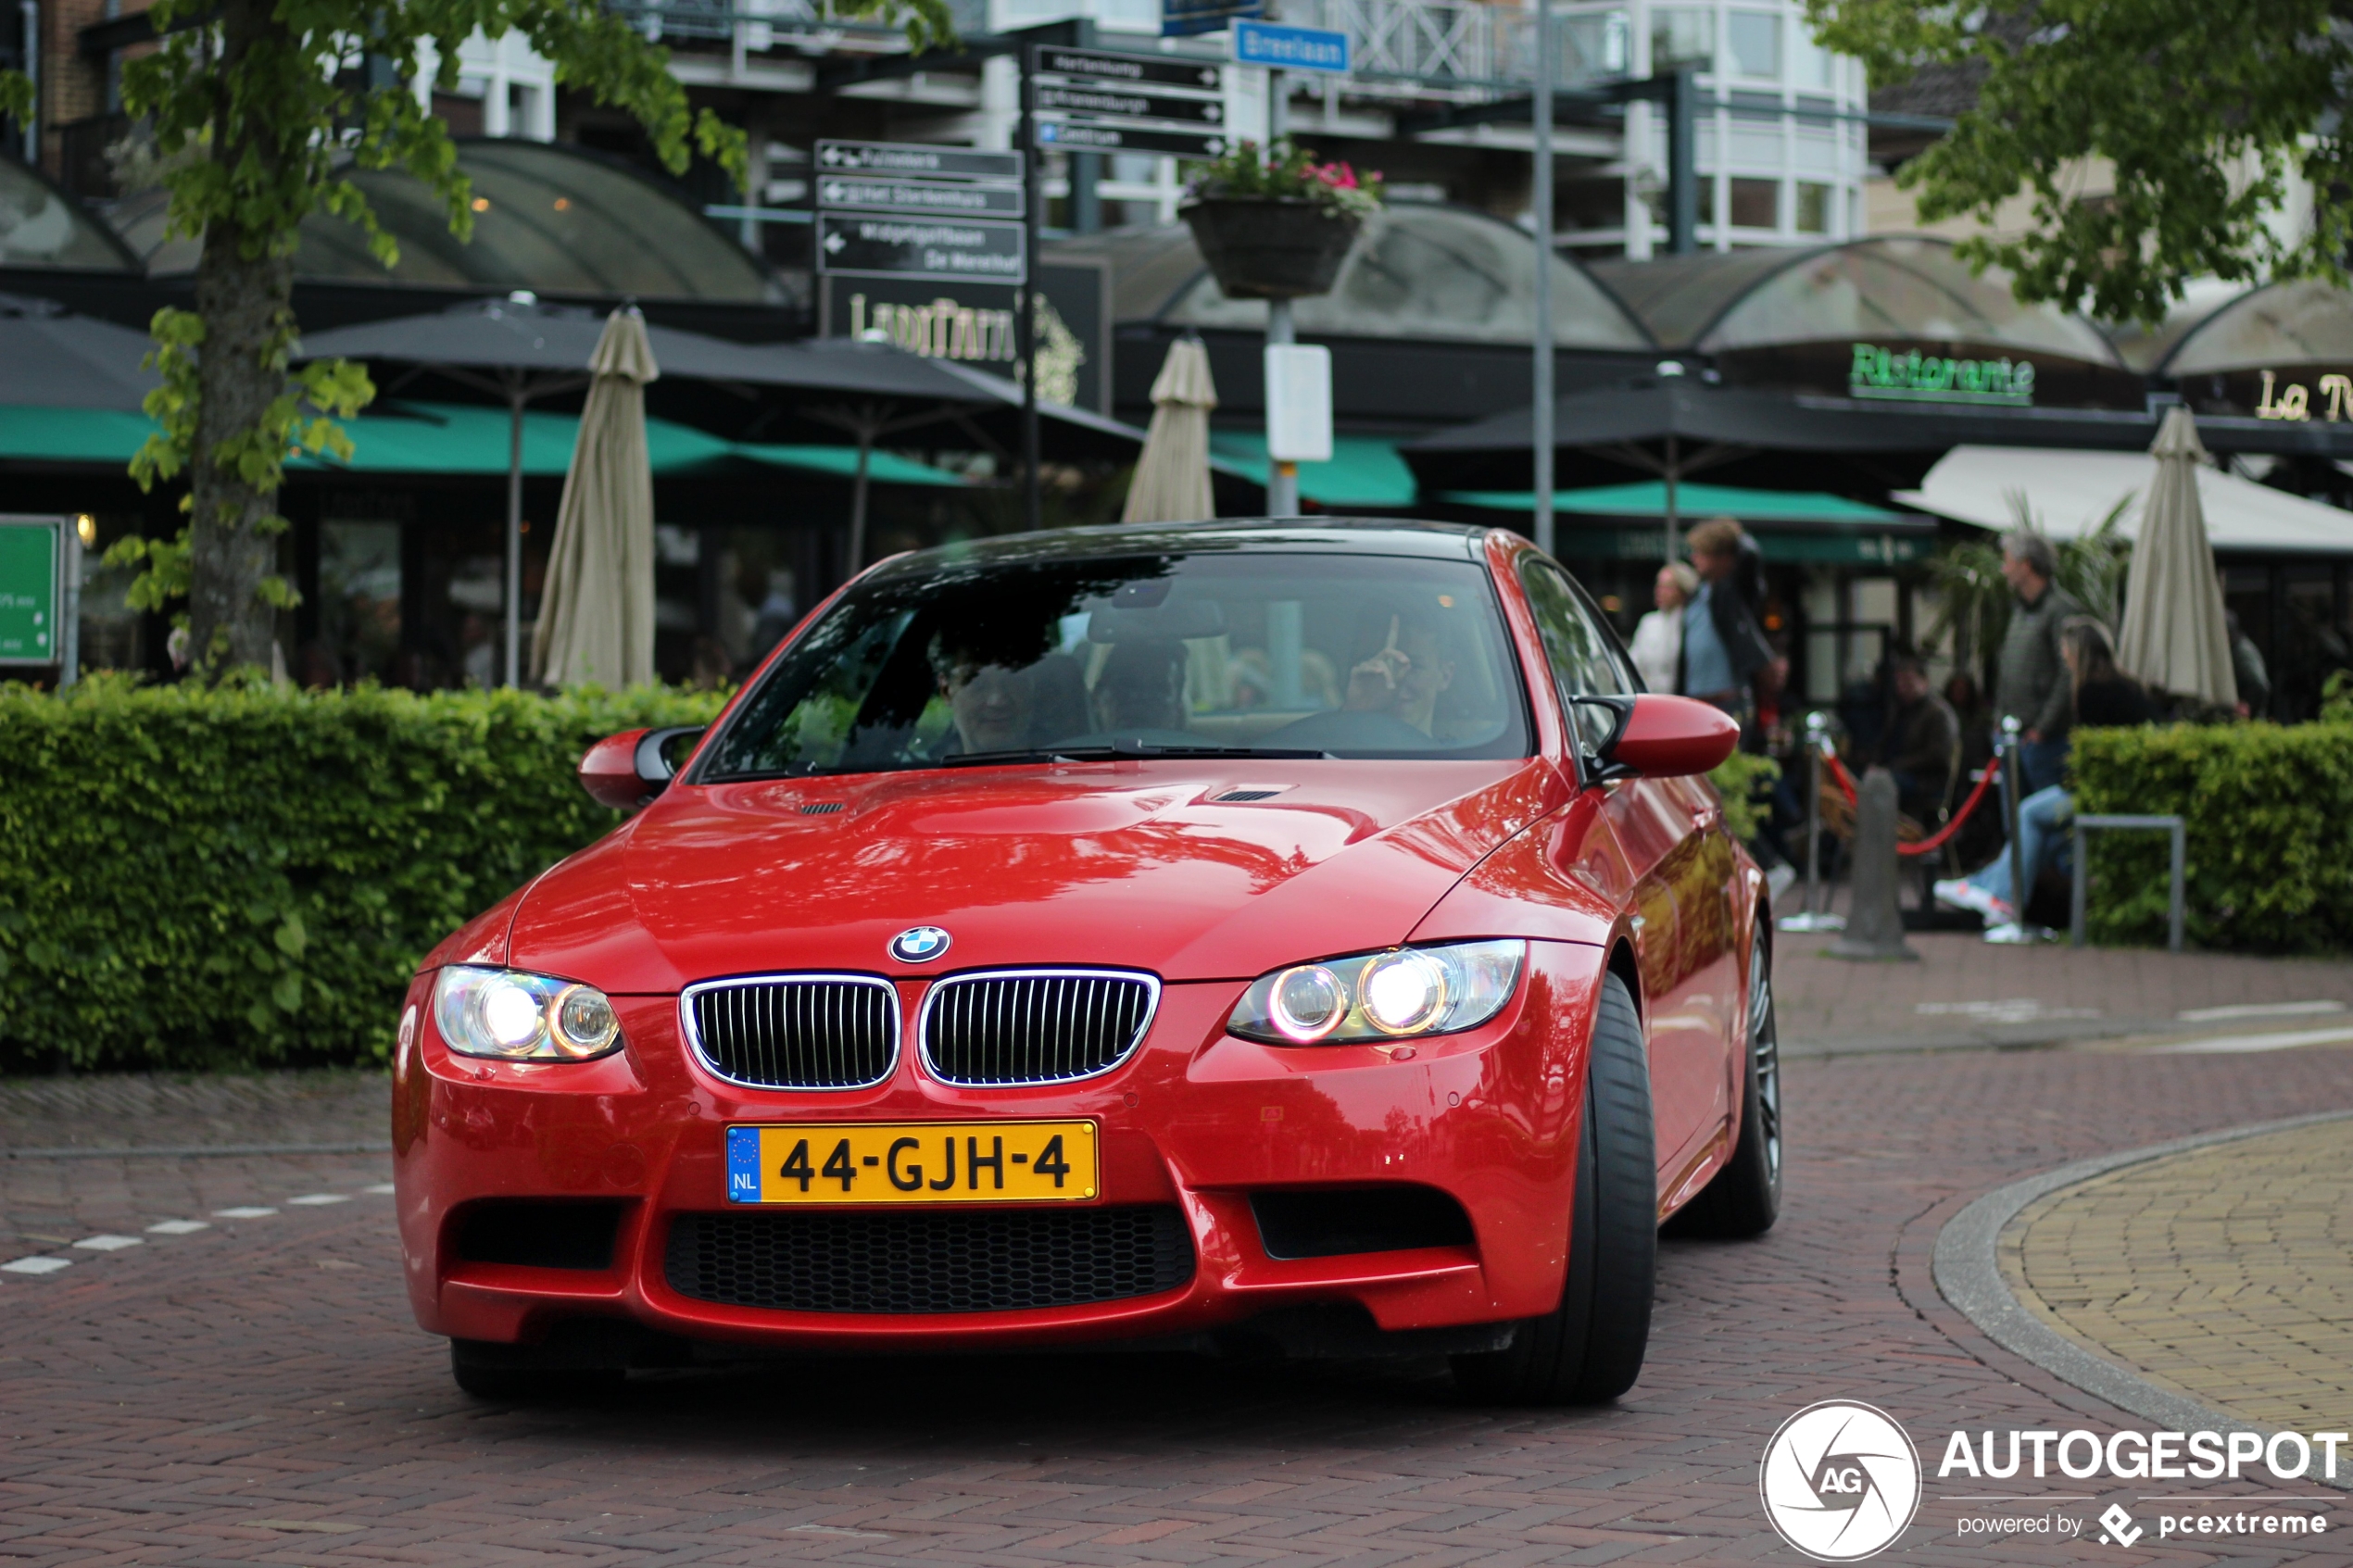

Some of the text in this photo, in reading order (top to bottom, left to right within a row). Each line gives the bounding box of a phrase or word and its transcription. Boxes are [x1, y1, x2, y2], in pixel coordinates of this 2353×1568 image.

[1243, 30, 1342, 64] Breelaan
[1057, 125, 1122, 144] Centrum
[2254, 370, 2312, 422] La
[734, 1134, 1071, 1192] NL 44-GJH-4
